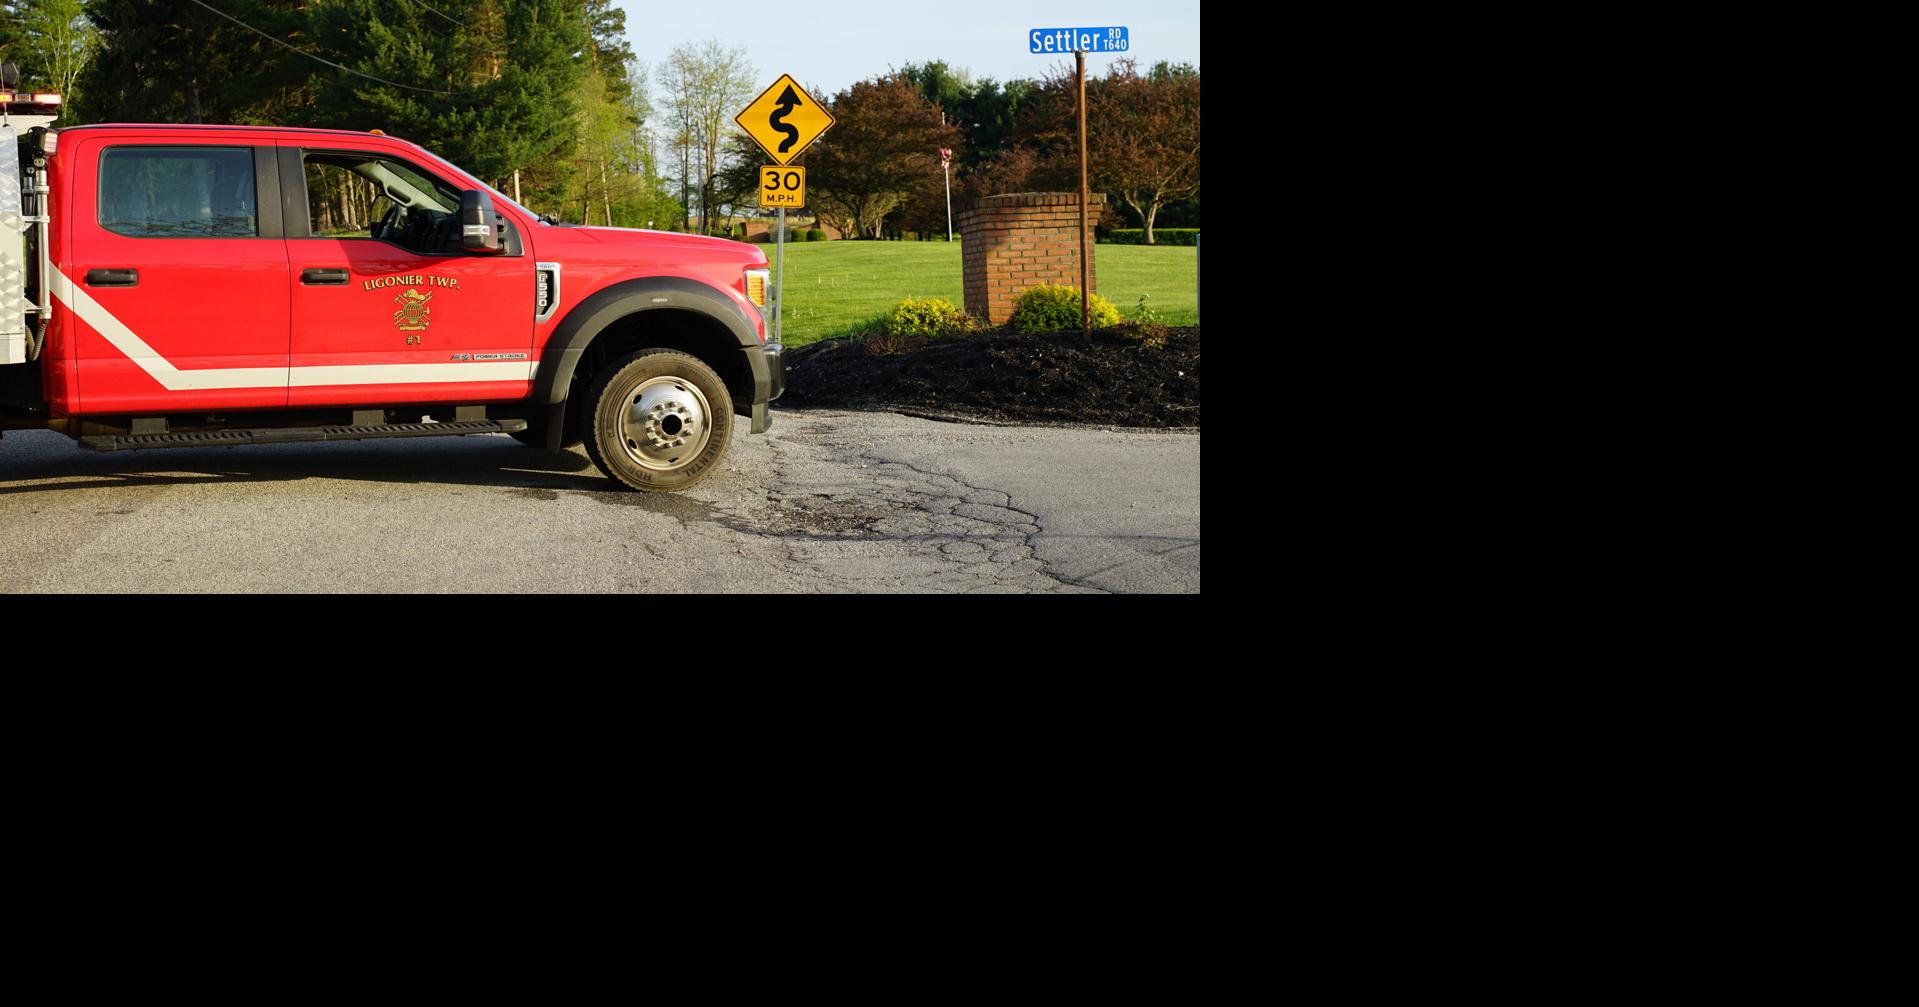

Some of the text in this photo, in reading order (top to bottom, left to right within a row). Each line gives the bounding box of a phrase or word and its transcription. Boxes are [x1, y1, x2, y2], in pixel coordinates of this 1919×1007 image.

[1032, 29, 1100, 52] Settler
[1108, 28, 1122, 39] RD
[1103, 38, 1127, 50] T640
[764, 171, 800, 191] 30
[766, 194, 797, 203] M.P.H.
[363, 275, 461, 292] LIGONIER TWP.
[406, 334, 422, 345] #1
[682, 407, 725, 477] CONTINENTAL
